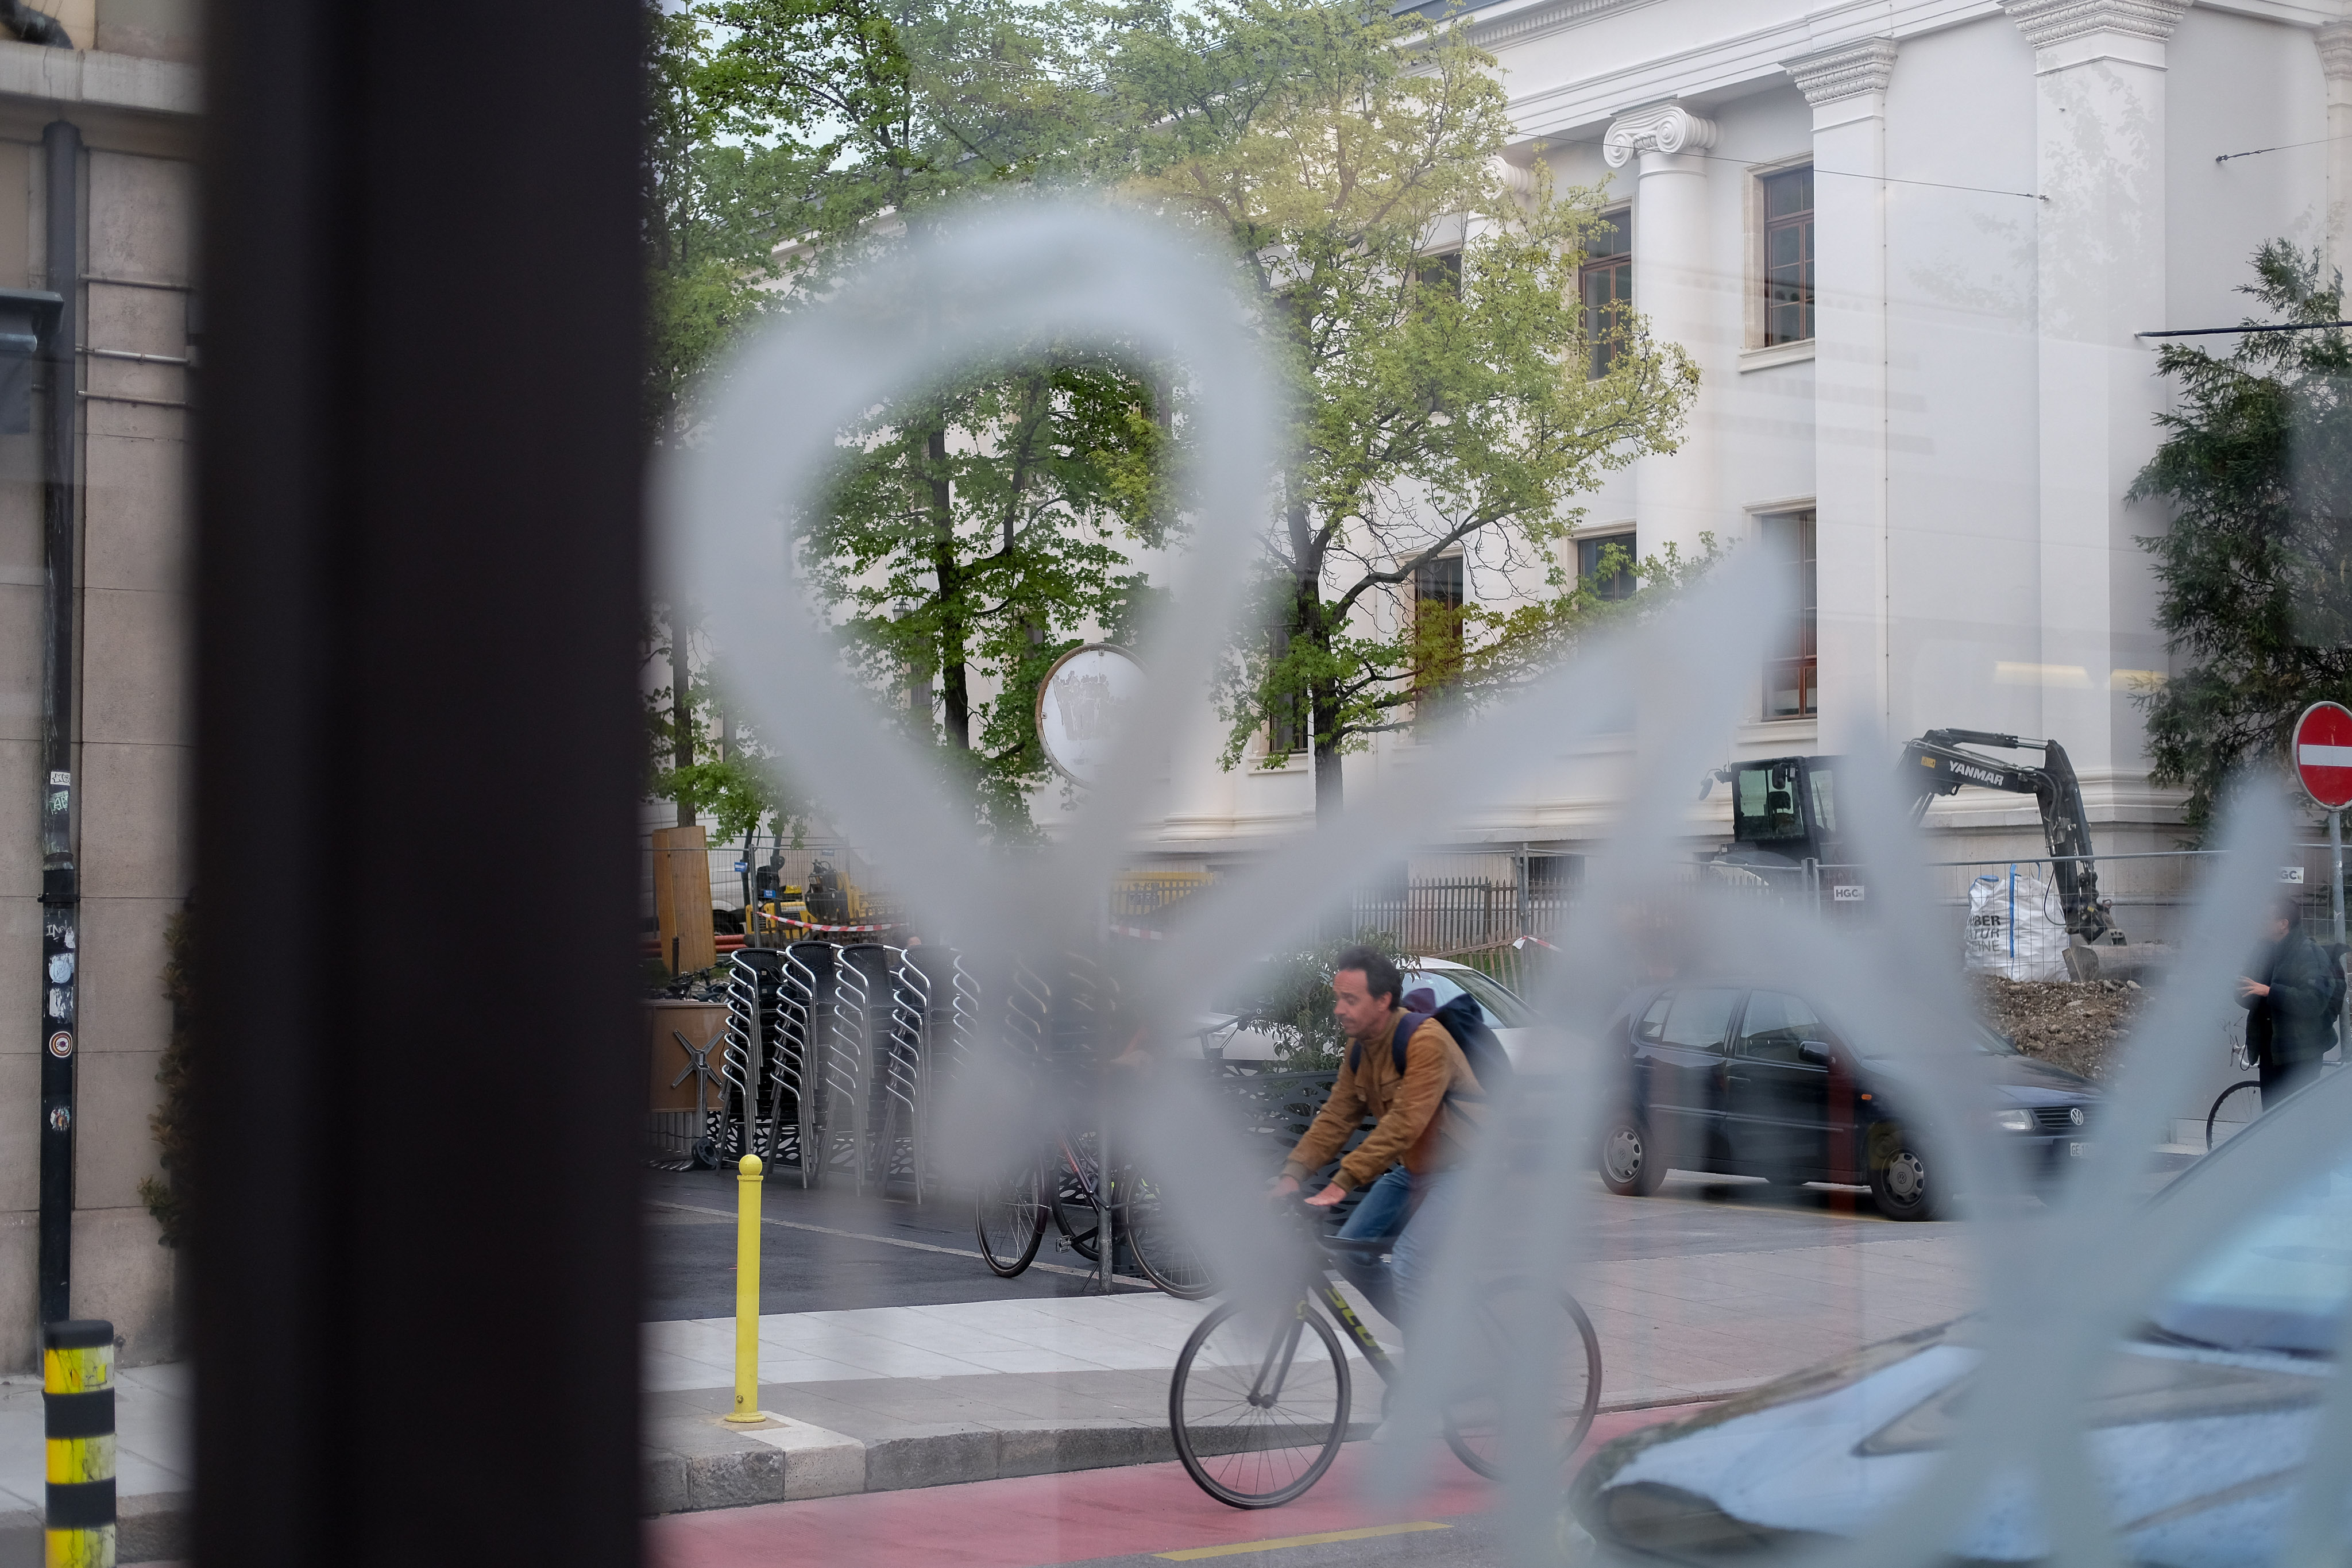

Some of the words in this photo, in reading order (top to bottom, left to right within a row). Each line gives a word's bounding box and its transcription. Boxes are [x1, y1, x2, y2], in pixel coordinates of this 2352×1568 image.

[1949, 760, 2004, 786] YANMAR
[2277, 870, 2297, 880] GC
[1836, 889, 1859, 898] HGC
